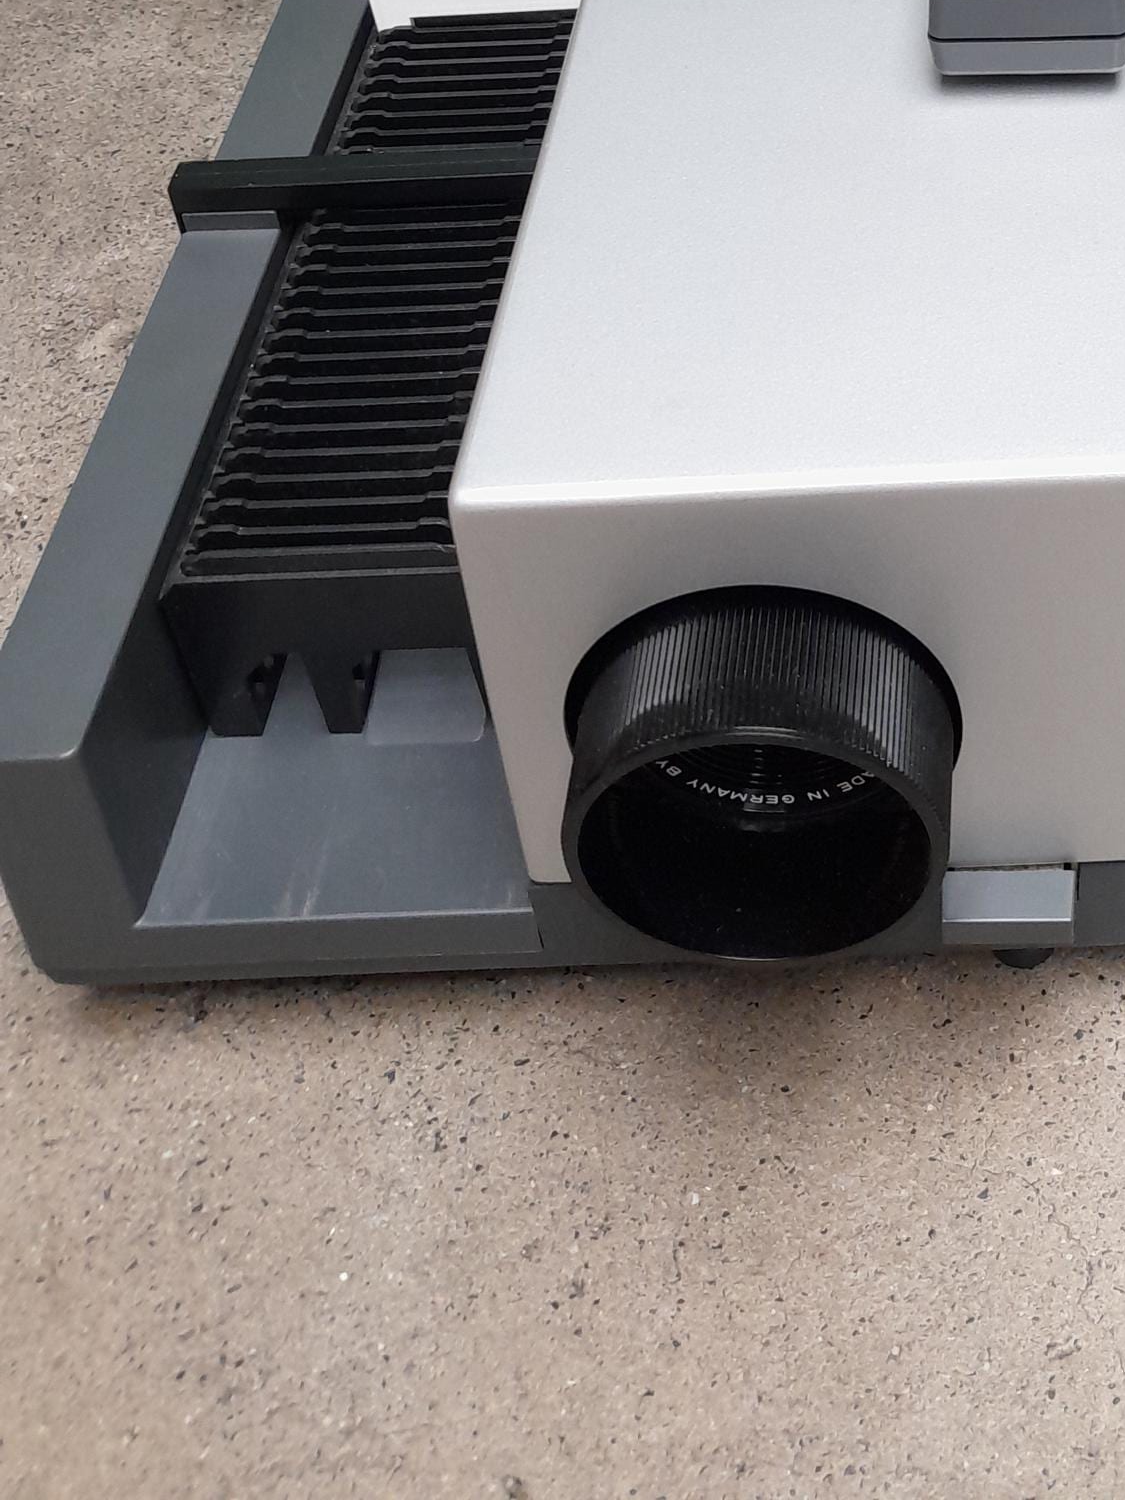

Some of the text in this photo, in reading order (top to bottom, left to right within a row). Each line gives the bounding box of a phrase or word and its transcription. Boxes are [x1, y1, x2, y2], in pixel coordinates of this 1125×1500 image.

[655, 760, 875, 804] ADE IN GERMANY BY
